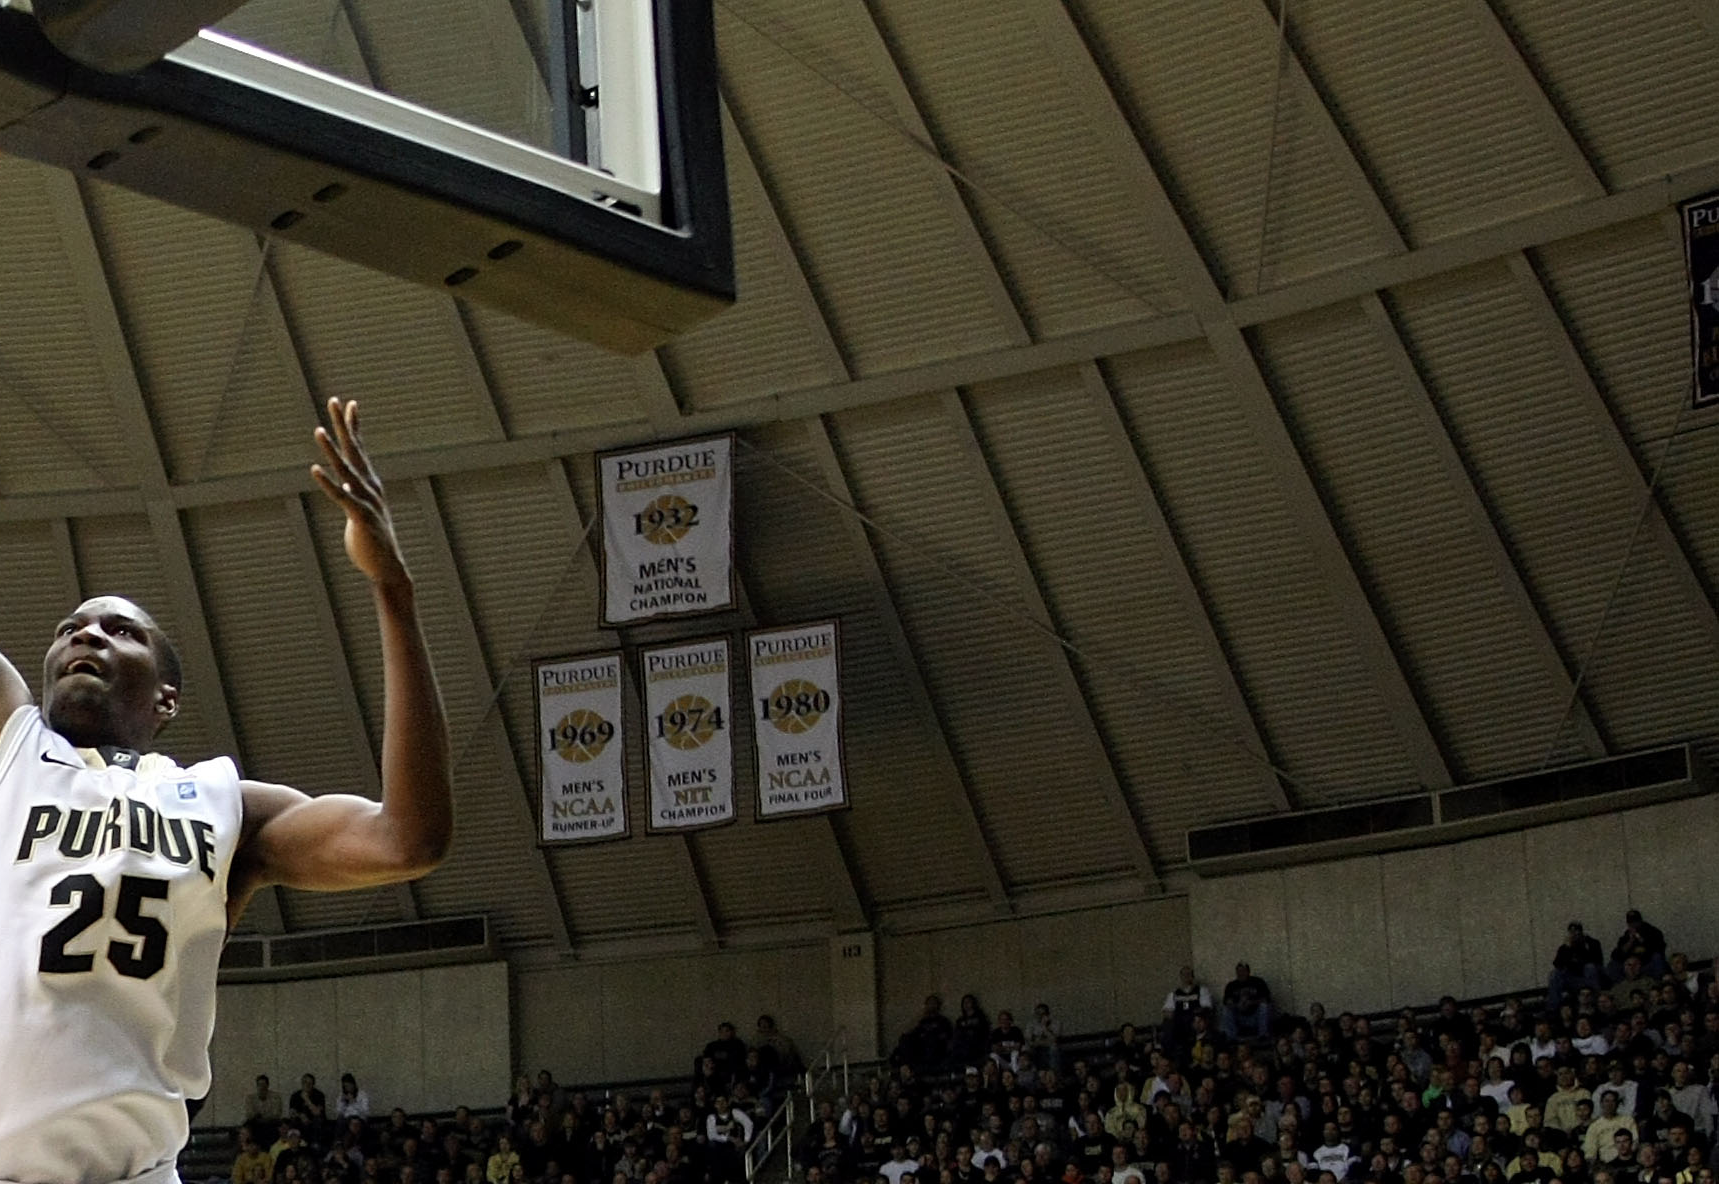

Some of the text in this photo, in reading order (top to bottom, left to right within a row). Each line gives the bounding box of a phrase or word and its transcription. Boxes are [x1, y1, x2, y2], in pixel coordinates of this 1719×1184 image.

[617, 450, 715, 480] PURDUE
[633, 505, 699, 535] 1932
[639, 557, 696, 579] MEN'S
[634, 577, 701, 595] NATIONAL
[630, 592, 707, 611] CHAMPION
[754, 632, 832, 656] PURDUE
[648, 649, 724, 672] PURDUE
[542, 664, 616, 686] PURDUE
[760, 689, 830, 720] 1980
[656, 706, 724, 738] 1974
[549, 720, 614, 751] 1969
[776, 751, 821, 766] MEN'S
[561, 780, 604, 796] MEN'S
[667, 769, 717, 787] MEN'S
[768, 769, 831, 790] NCAA
[674, 788, 713, 806] NIT
[768, 788, 832, 805] FINAL FOUR
[552, 797, 615, 819] NCAA
[660, 804, 726, 820] CHAMPION
[552, 818, 615, 833] RUNNER-UP
[14, 795, 216, 882] PURDUE
[38, 874, 170, 980] 25
